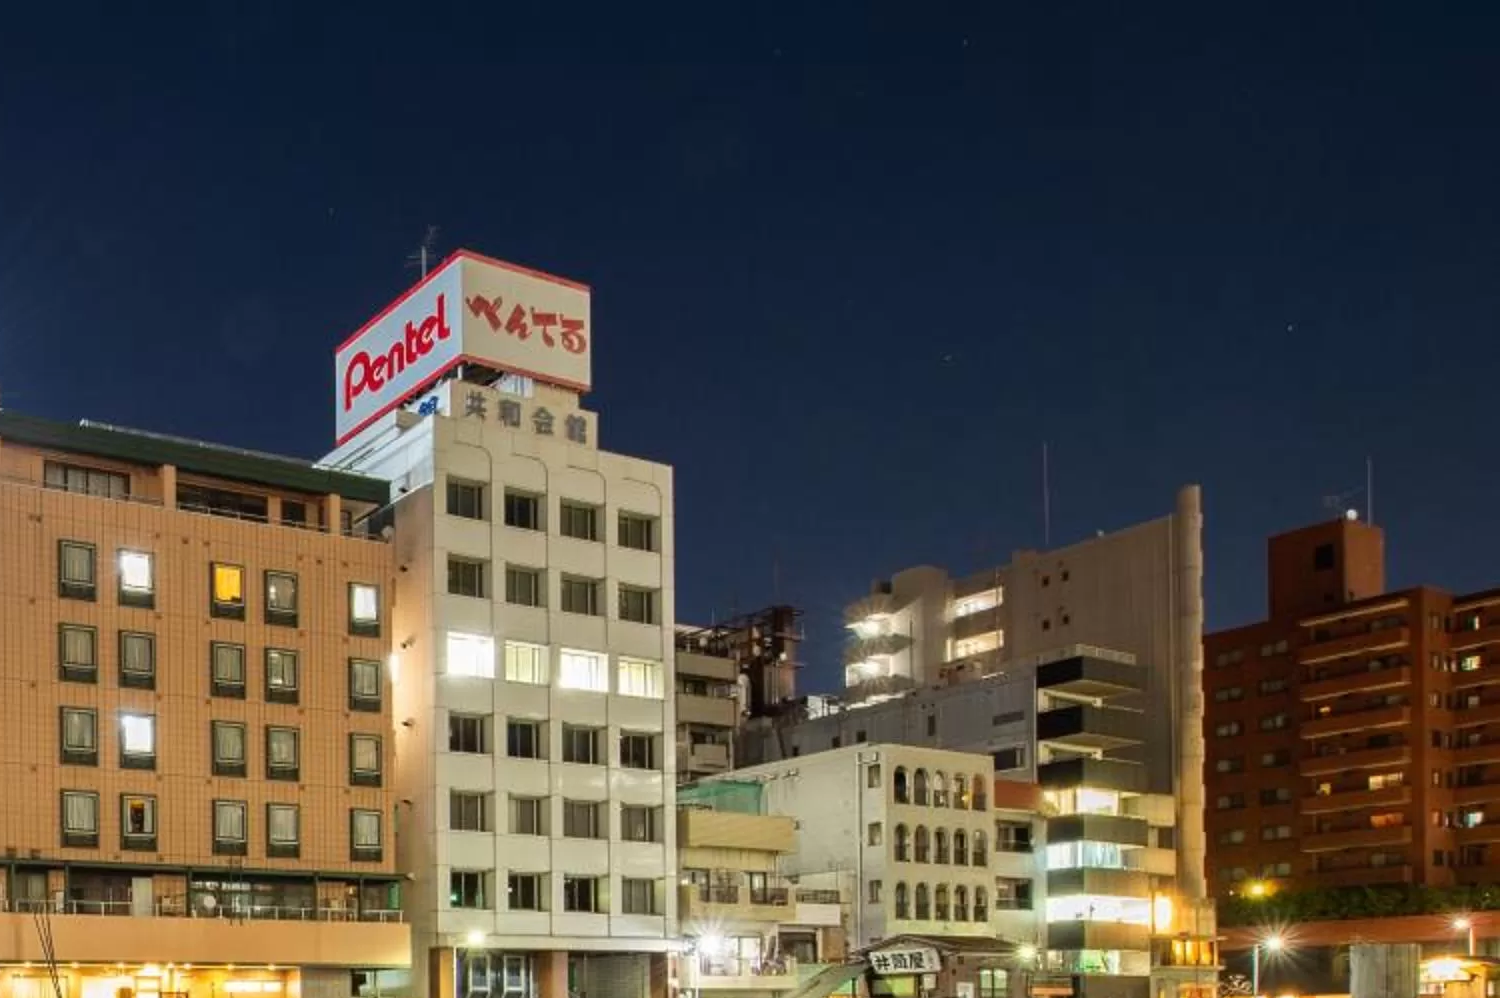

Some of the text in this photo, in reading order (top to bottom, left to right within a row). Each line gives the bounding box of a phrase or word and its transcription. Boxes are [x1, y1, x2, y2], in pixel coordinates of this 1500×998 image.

[344, 293, 451, 413] Pentel
[466, 294, 587, 354] ぺんてる
[874, 951, 925, 972] 井筒屋
